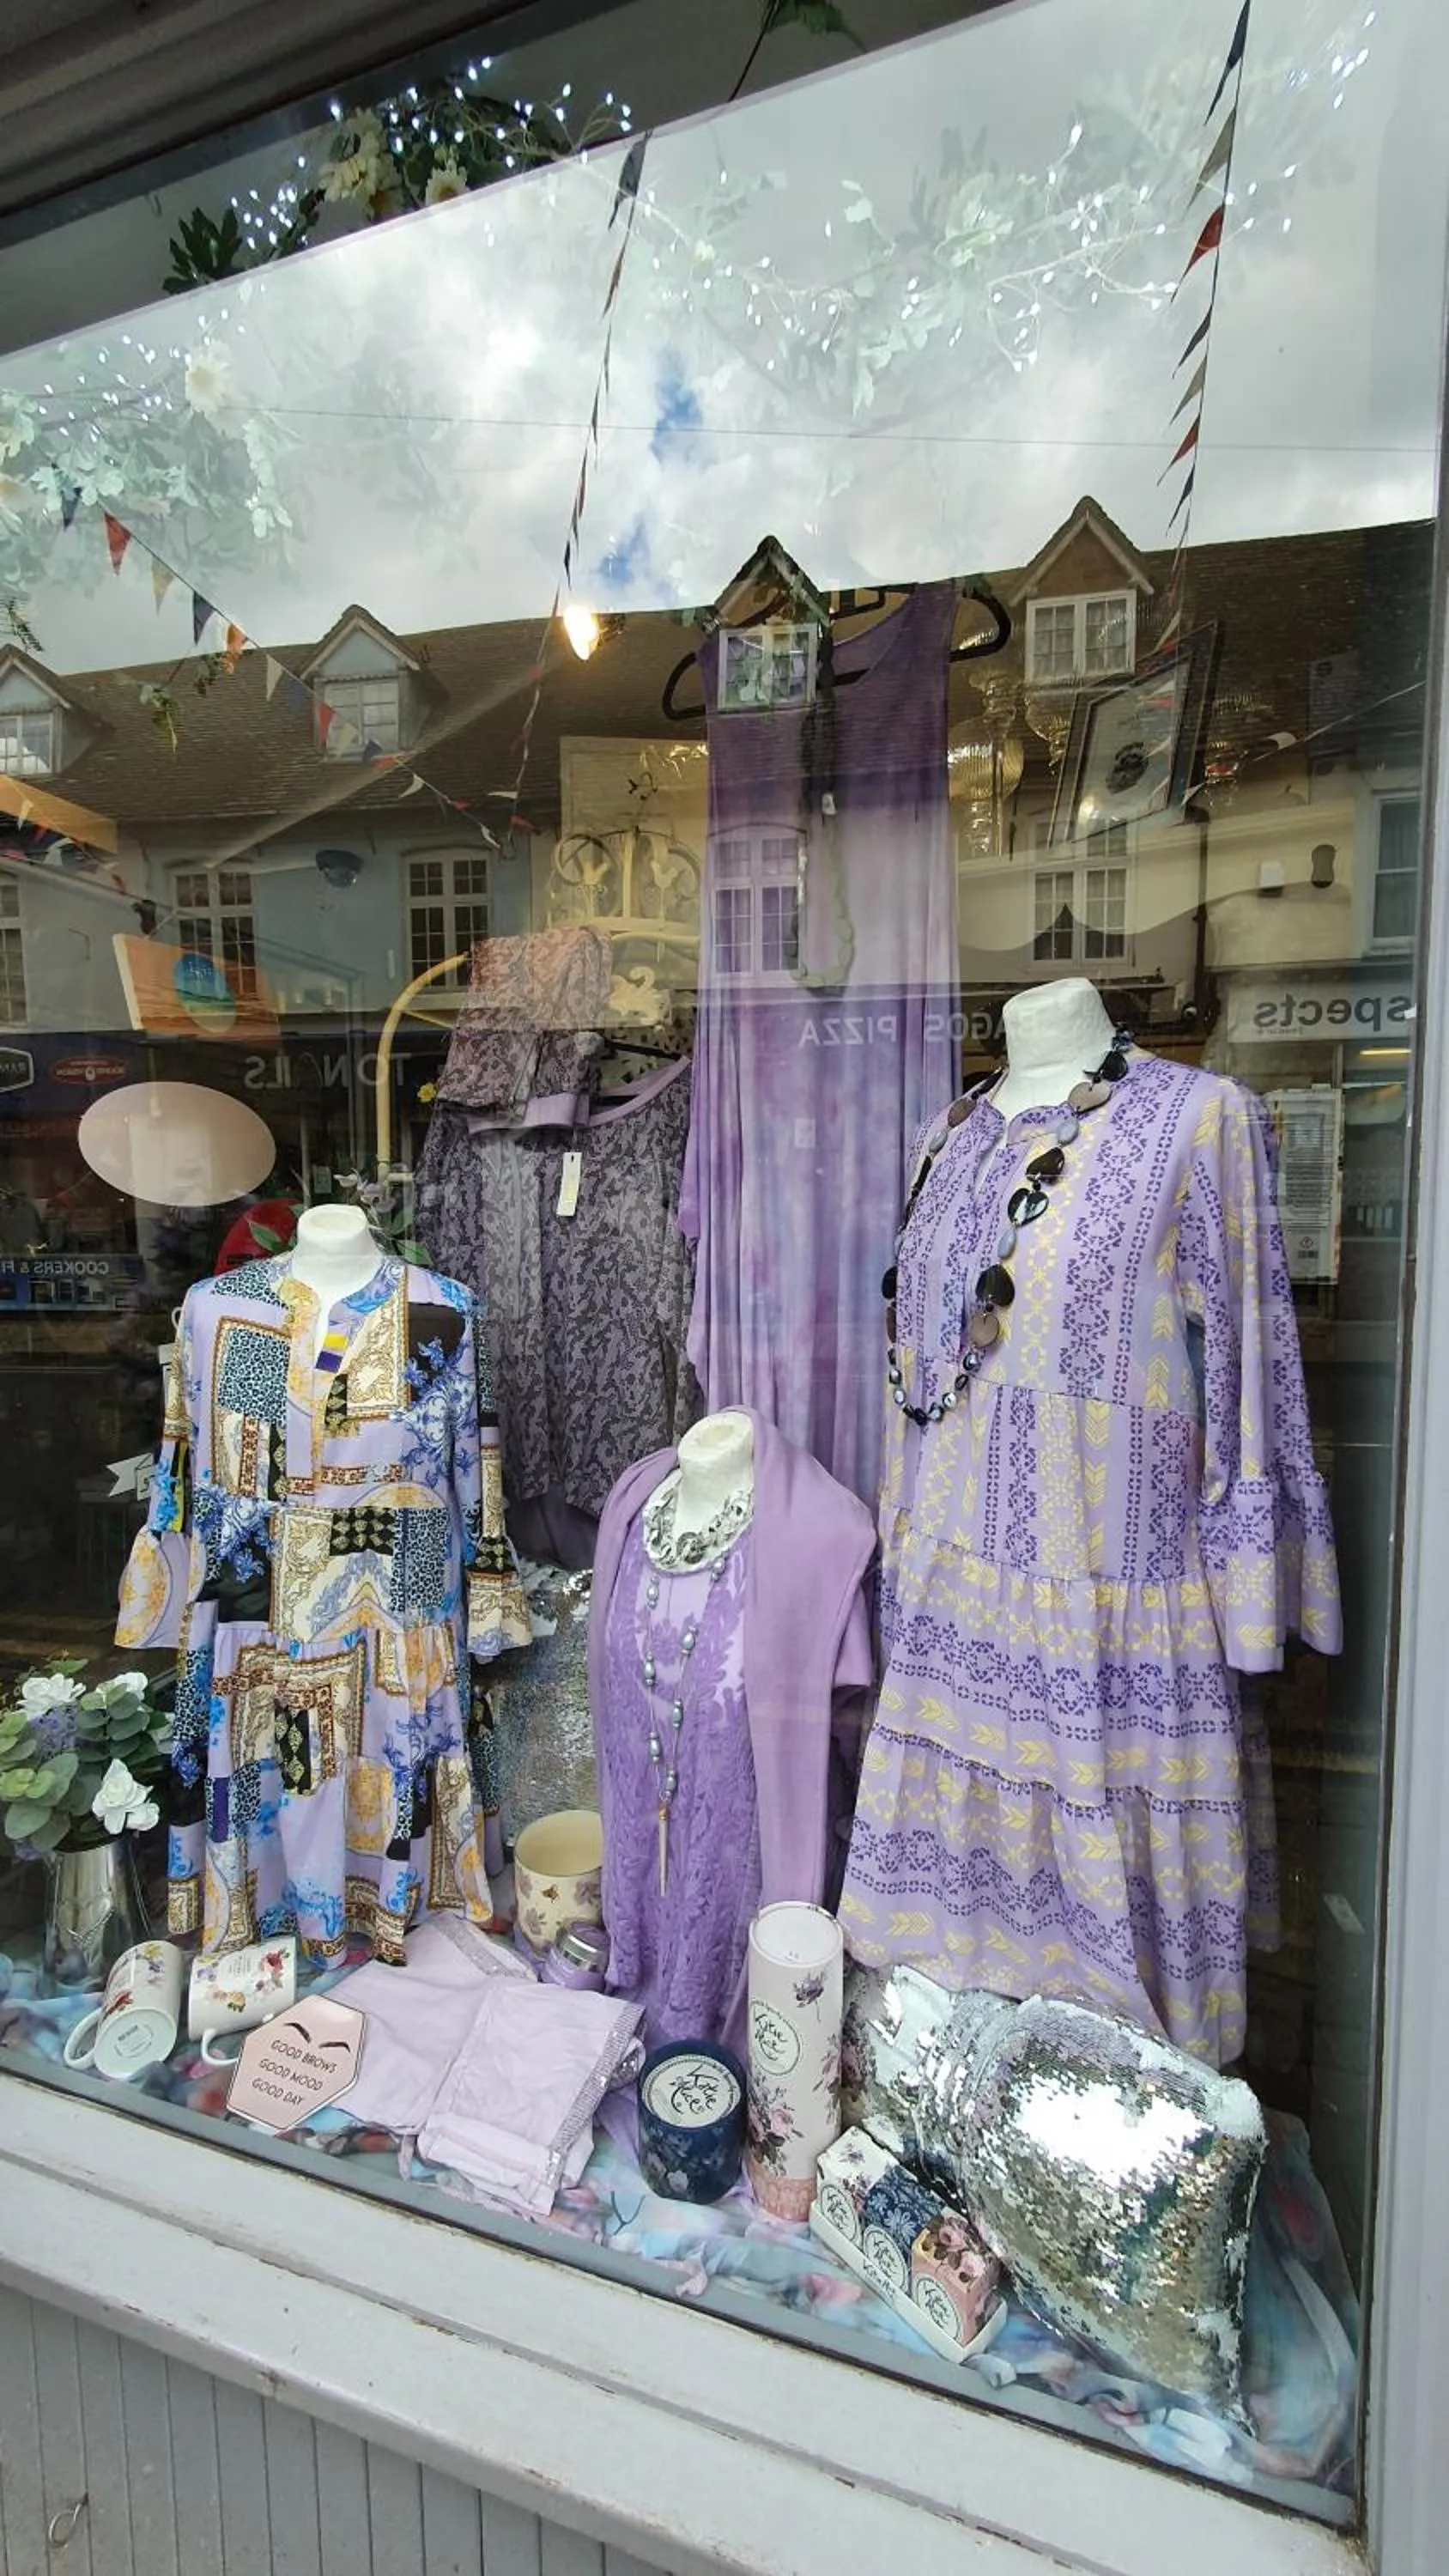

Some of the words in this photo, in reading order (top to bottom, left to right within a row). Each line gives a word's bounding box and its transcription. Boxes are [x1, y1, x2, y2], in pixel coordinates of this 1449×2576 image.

[270, 2039, 303, 2060] GOOD
[301, 2051, 337, 2074] BROWS
[252, 2077, 284, 2099] GOOD
[282, 2091, 305, 2105] DAY
[259, 2058, 290, 2077] GOOD
[289, 2073, 323, 2091] MOOD
